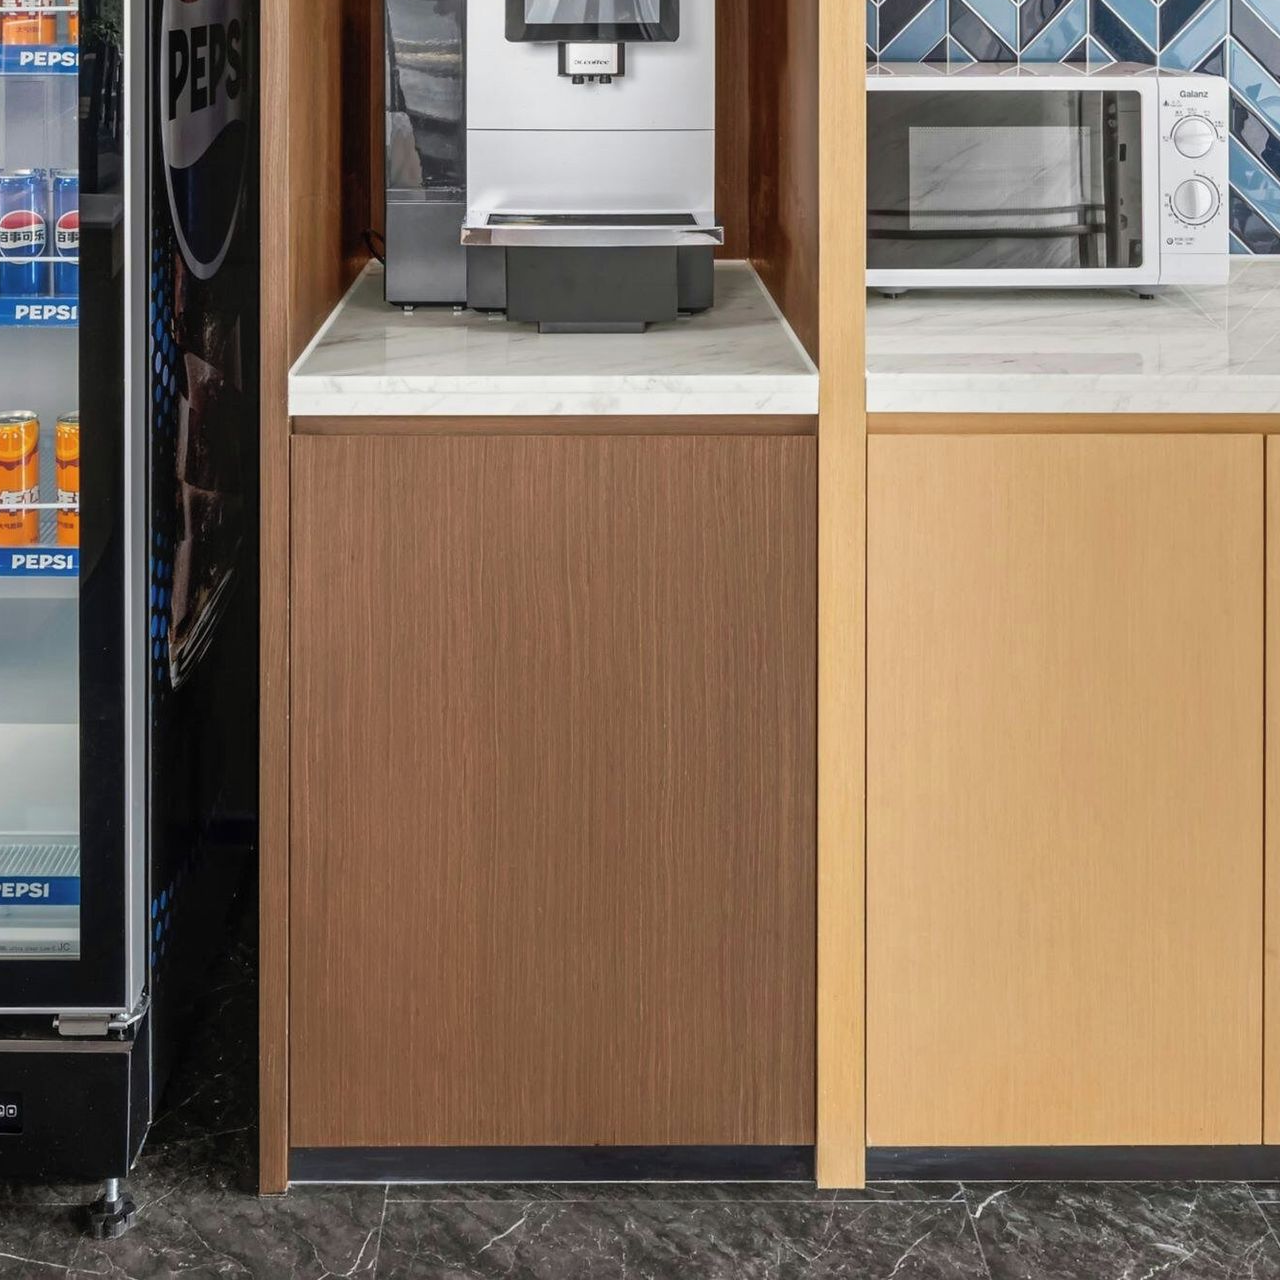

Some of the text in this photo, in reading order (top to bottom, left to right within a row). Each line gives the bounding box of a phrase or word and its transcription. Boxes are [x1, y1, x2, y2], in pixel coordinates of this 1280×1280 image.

[1179, 89, 1209, 98] Galanz
[0, 229, 46, 244] 百事可乐
[15, 306, 76, 319] PEPSI
[12, 555, 73, 569] PEPSI
